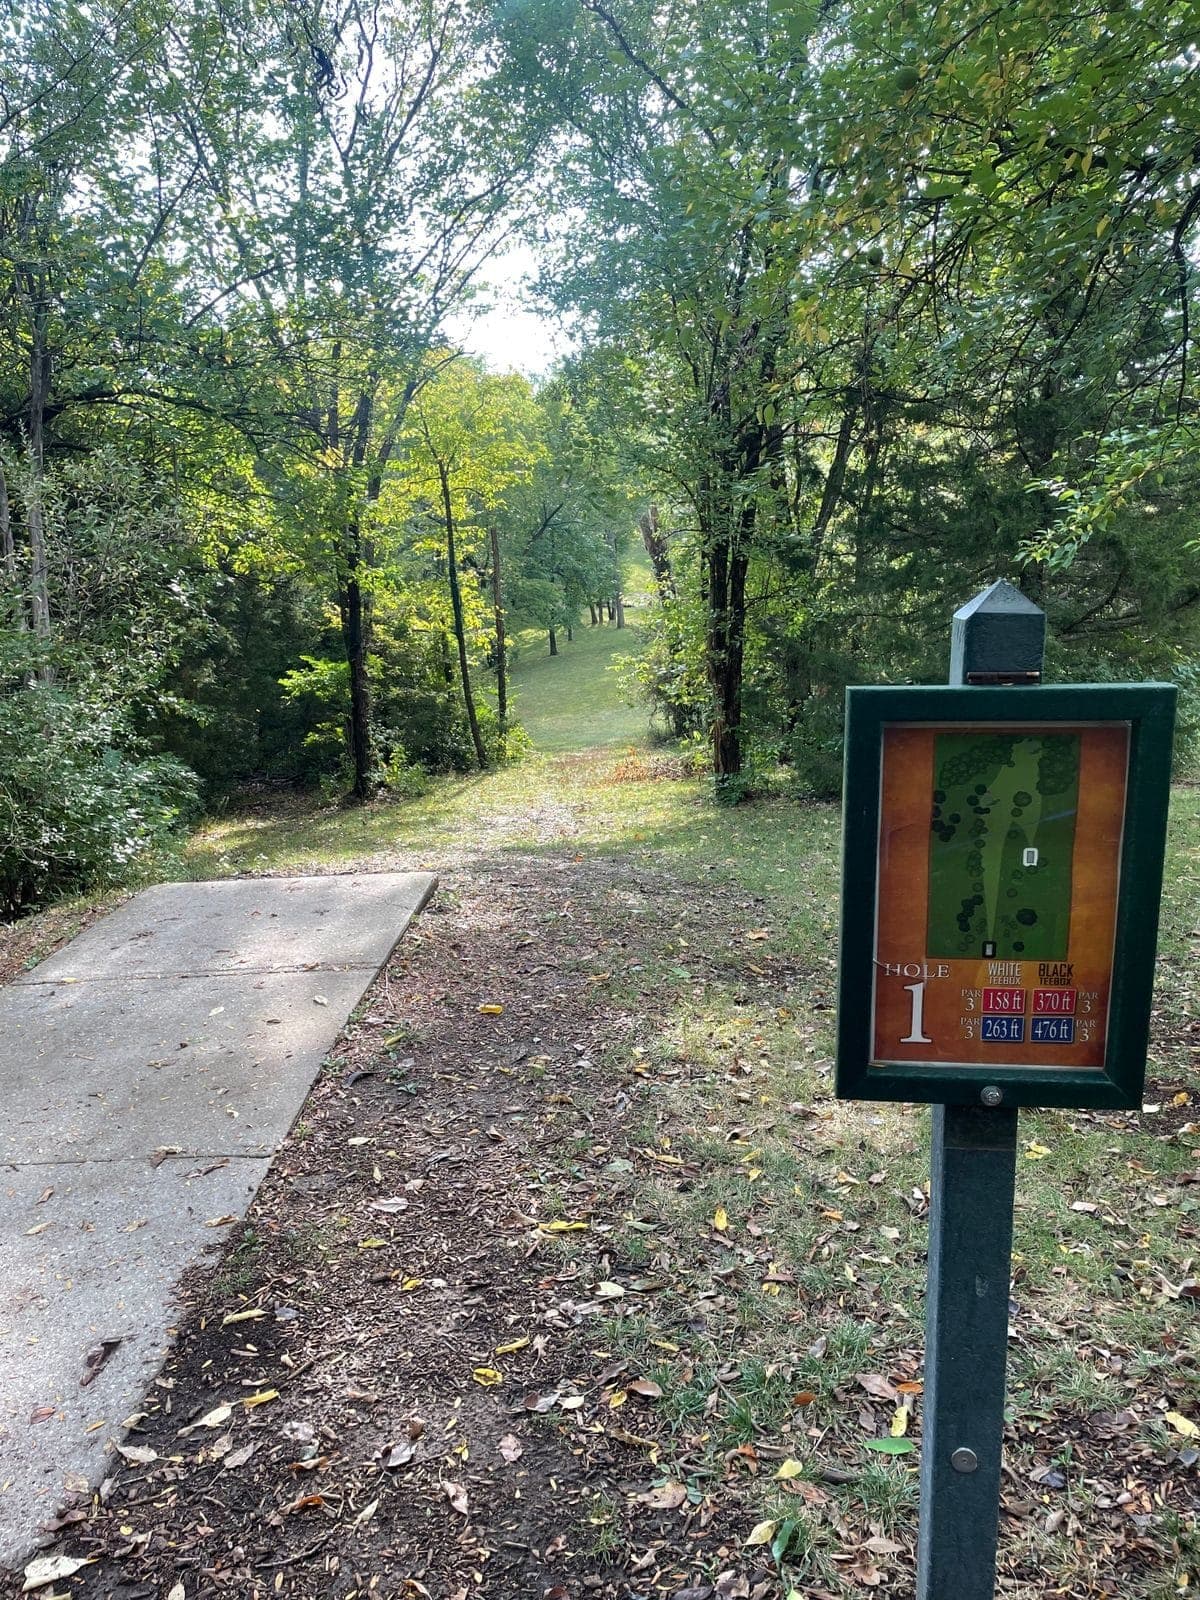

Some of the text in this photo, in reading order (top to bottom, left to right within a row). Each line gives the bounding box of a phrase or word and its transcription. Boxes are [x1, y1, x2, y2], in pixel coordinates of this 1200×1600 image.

[885, 963, 950, 978] HOLE
[988, 962, 1021, 976] WHITE
[1039, 963, 1074, 977] BLACK
[988, 976, 1021, 984] TEEBOX
[1040, 977, 1071, 985] TEEBOX
[961, 988, 982, 997] PAR
[1078, 991, 1098, 1000] PAR
[965, 998, 974, 1011] 3
[1082, 1001, 1091, 1013] 3
[900, 982, 932, 1043] 1
[960, 1017, 981, 1025] PAR
[1077, 1020, 1096, 1028] PAR
[964, 1026, 974, 1039] 3
[1080, 1029, 1089, 1041] 3
